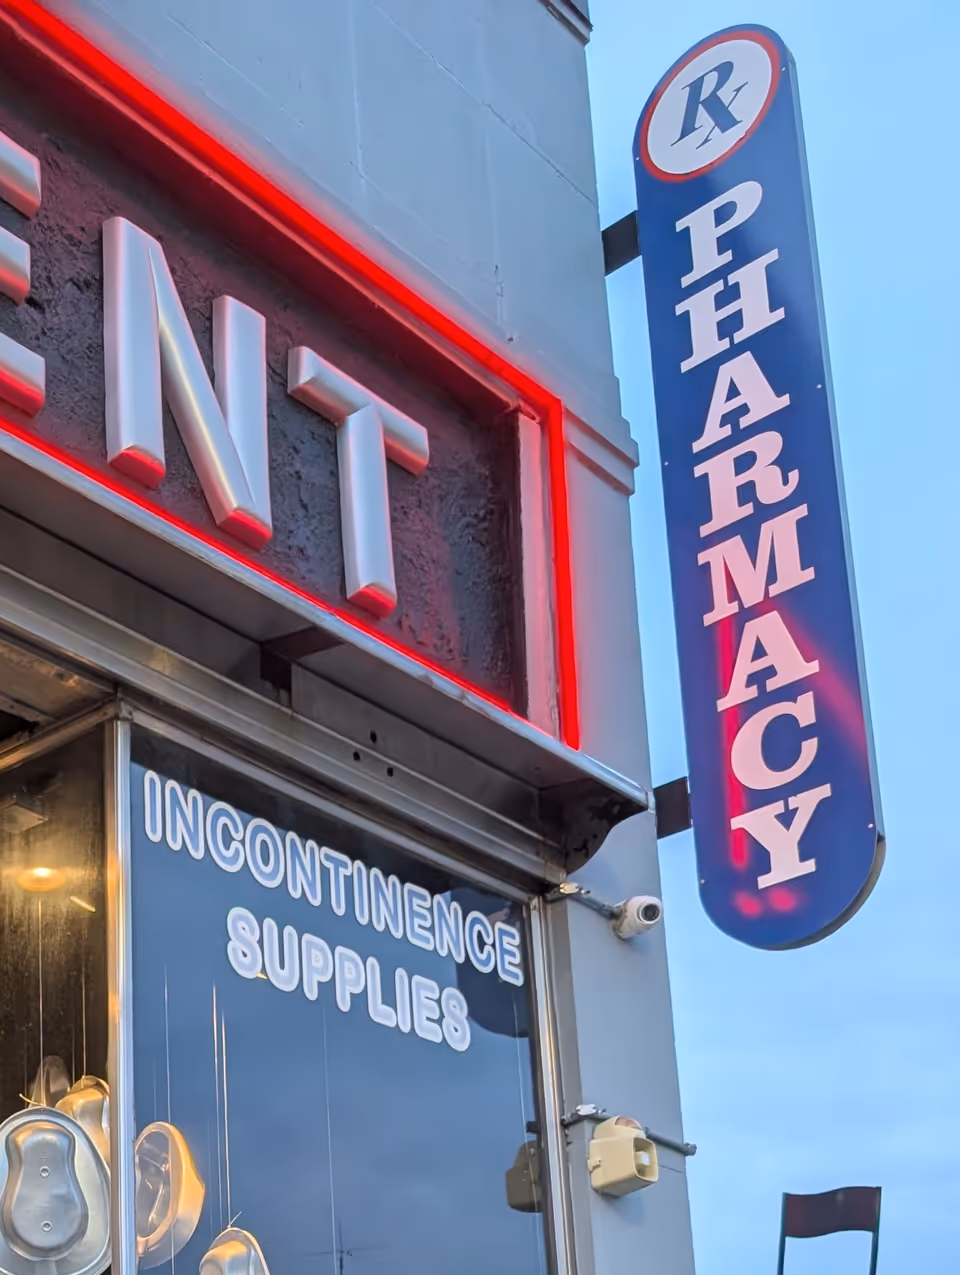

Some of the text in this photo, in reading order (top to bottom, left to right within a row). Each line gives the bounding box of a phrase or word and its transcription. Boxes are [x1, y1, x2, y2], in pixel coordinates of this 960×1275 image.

[675, 181, 831, 889] PHARMACY
[144, 770, 524, 986] INCONTINENCE
[227, 907, 471, 1052] SUPPLIES
